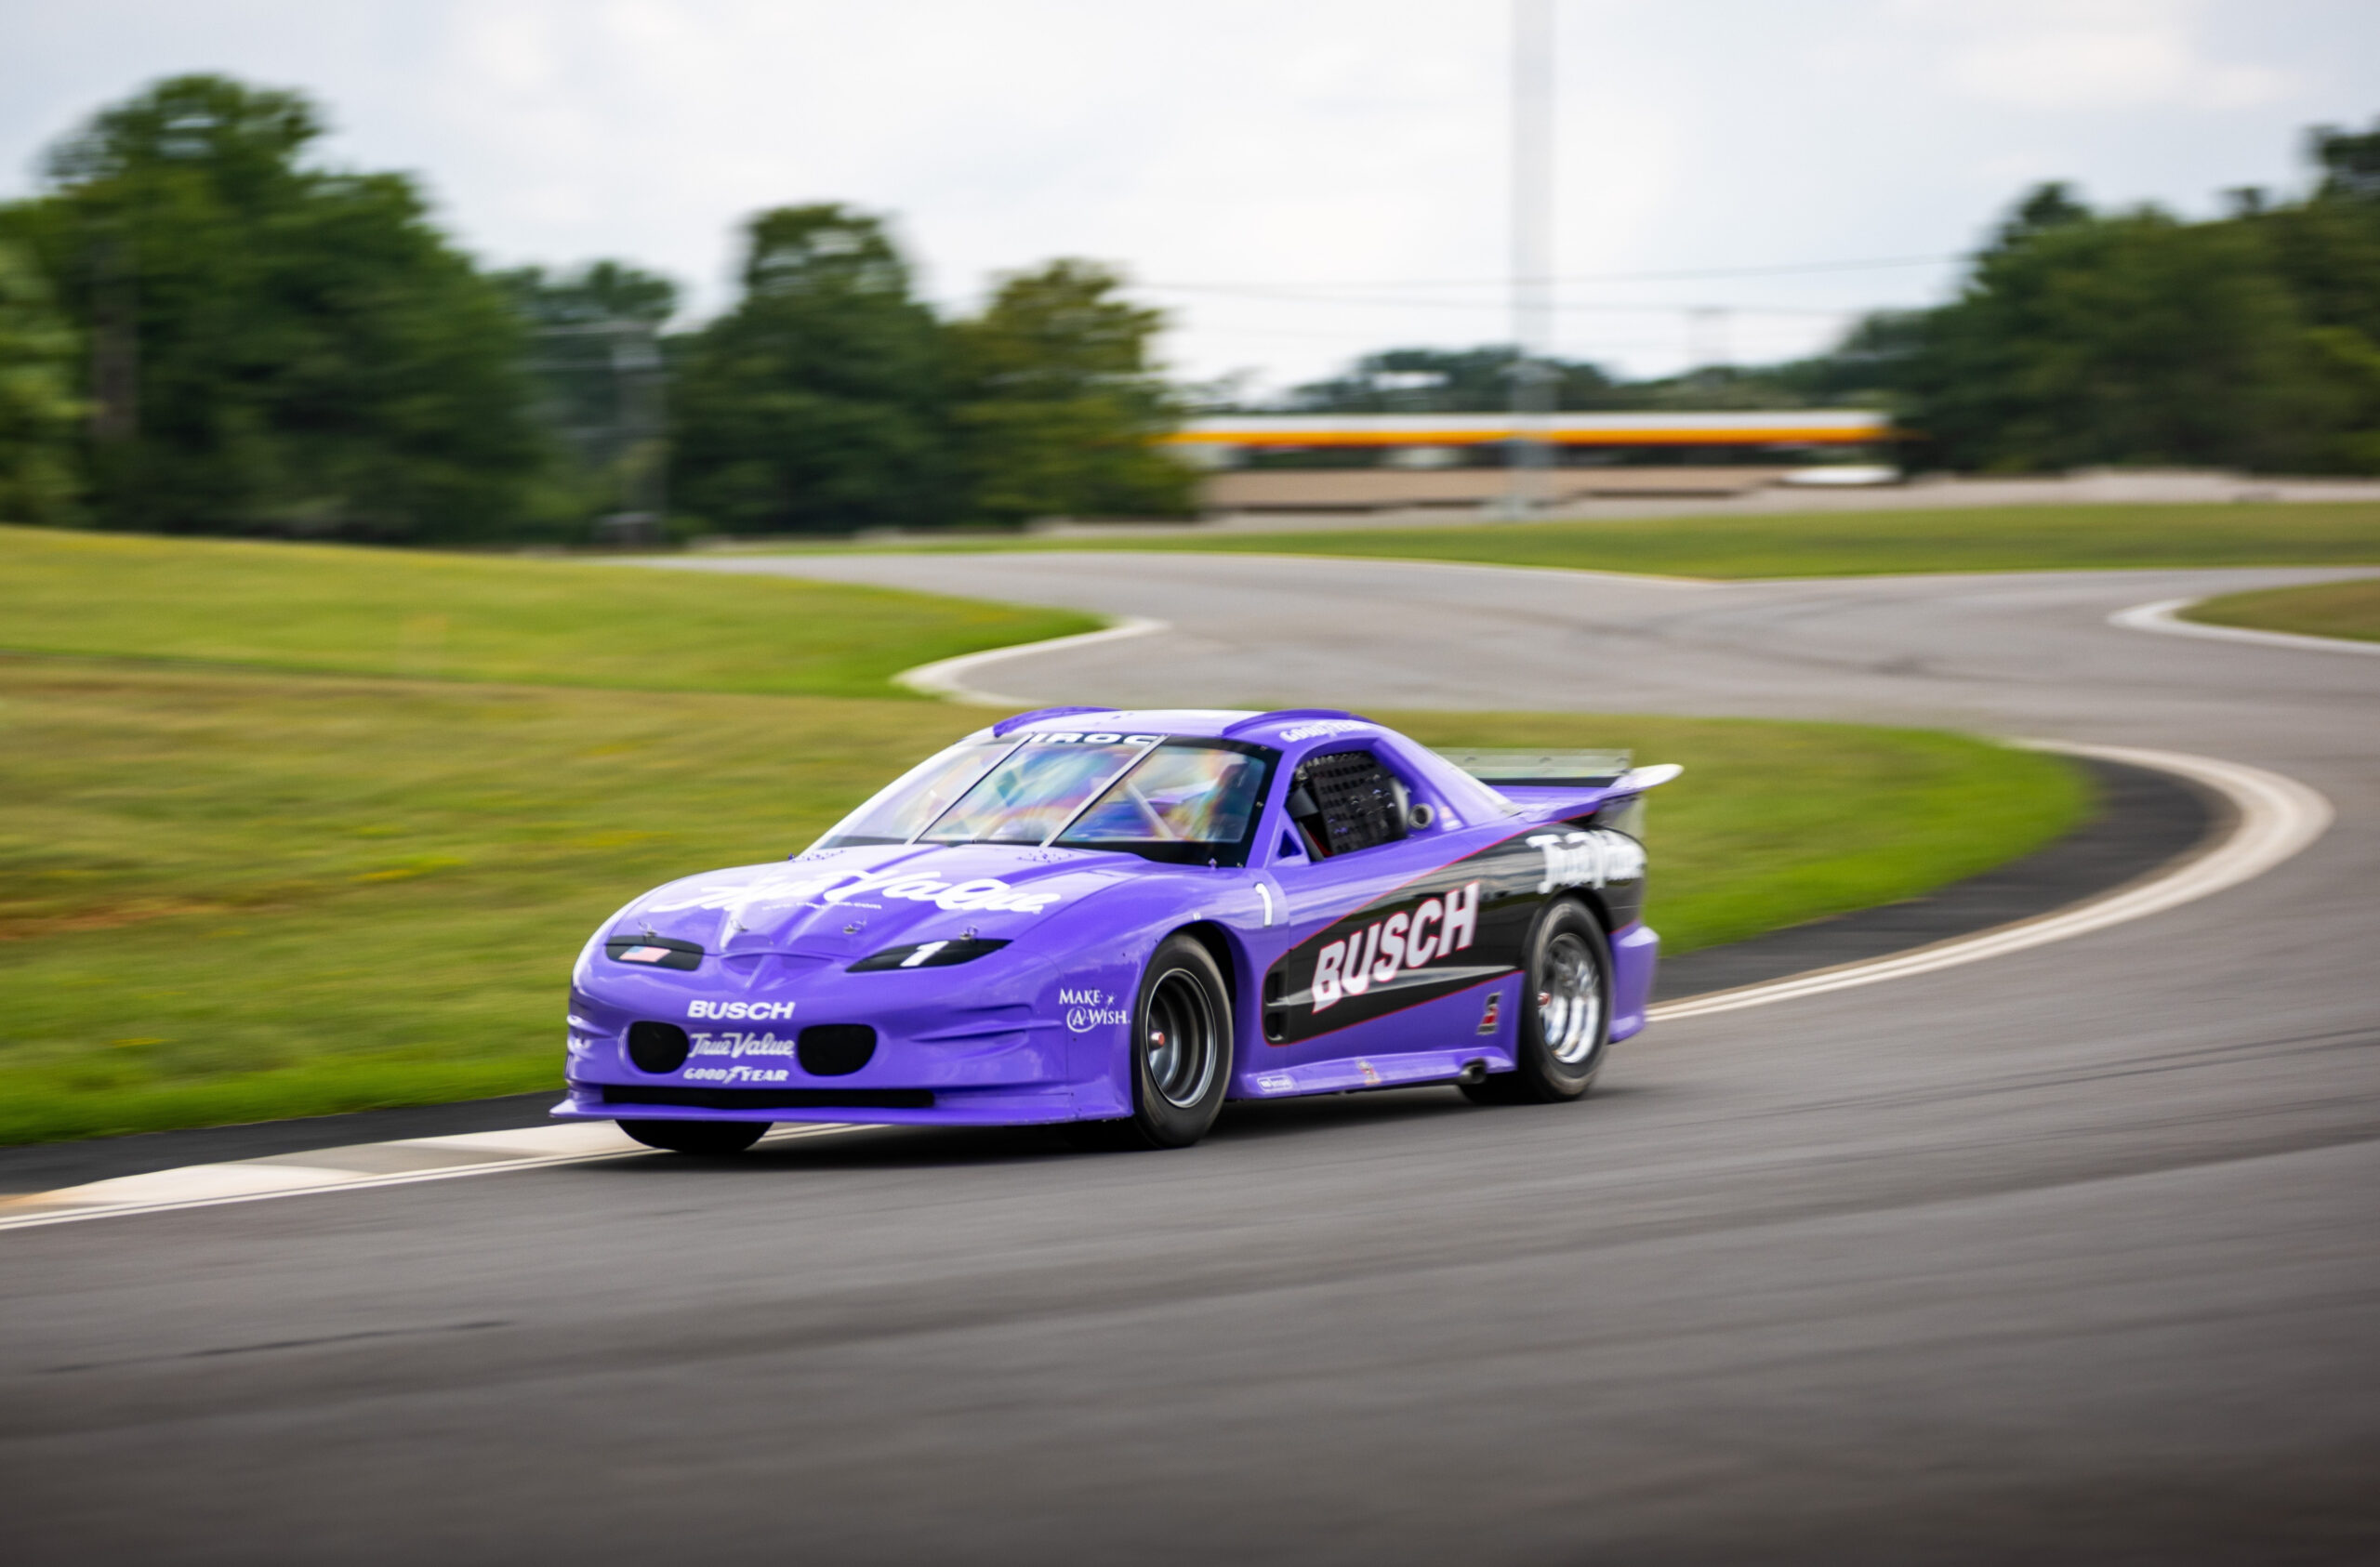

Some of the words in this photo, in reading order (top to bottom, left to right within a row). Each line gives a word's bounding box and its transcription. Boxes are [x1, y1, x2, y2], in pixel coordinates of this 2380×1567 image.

[1029, 732, 1159, 744] IROC
[1255, 882, 1273, 927] 1
[899, 940, 949, 967] 1
[1312, 879, 1480, 1015] BUSCH
[1059, 988, 1101, 1007] MAKE
[687, 1000, 796, 1021] BUSCH
[1087, 1008, 1127, 1025] WISH
[683, 1066, 789, 1084] GOODYEAR
